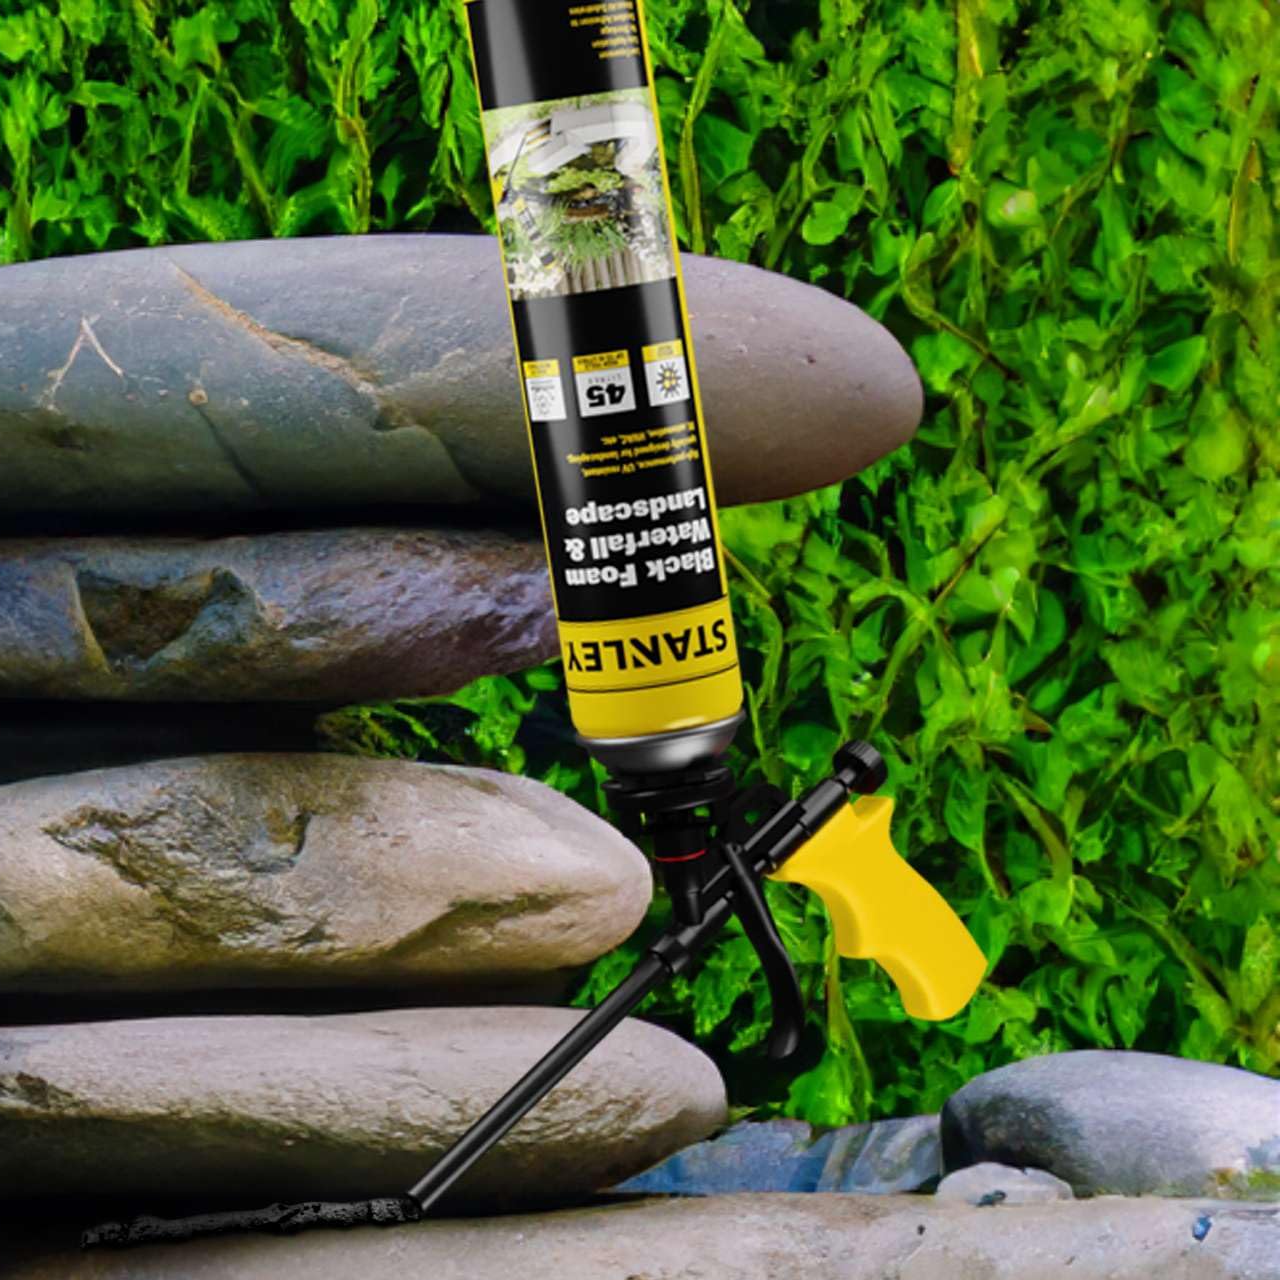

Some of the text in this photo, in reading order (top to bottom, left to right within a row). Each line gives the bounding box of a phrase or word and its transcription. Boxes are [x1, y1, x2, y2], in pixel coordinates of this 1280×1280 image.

[586, 383, 626, 408] 45
[565, 487, 706, 525] Landscape
[564, 517, 711, 562] Waterfall &
[565, 547, 715, 588] Black Foam
[568, 619, 728, 672] STANLEY
